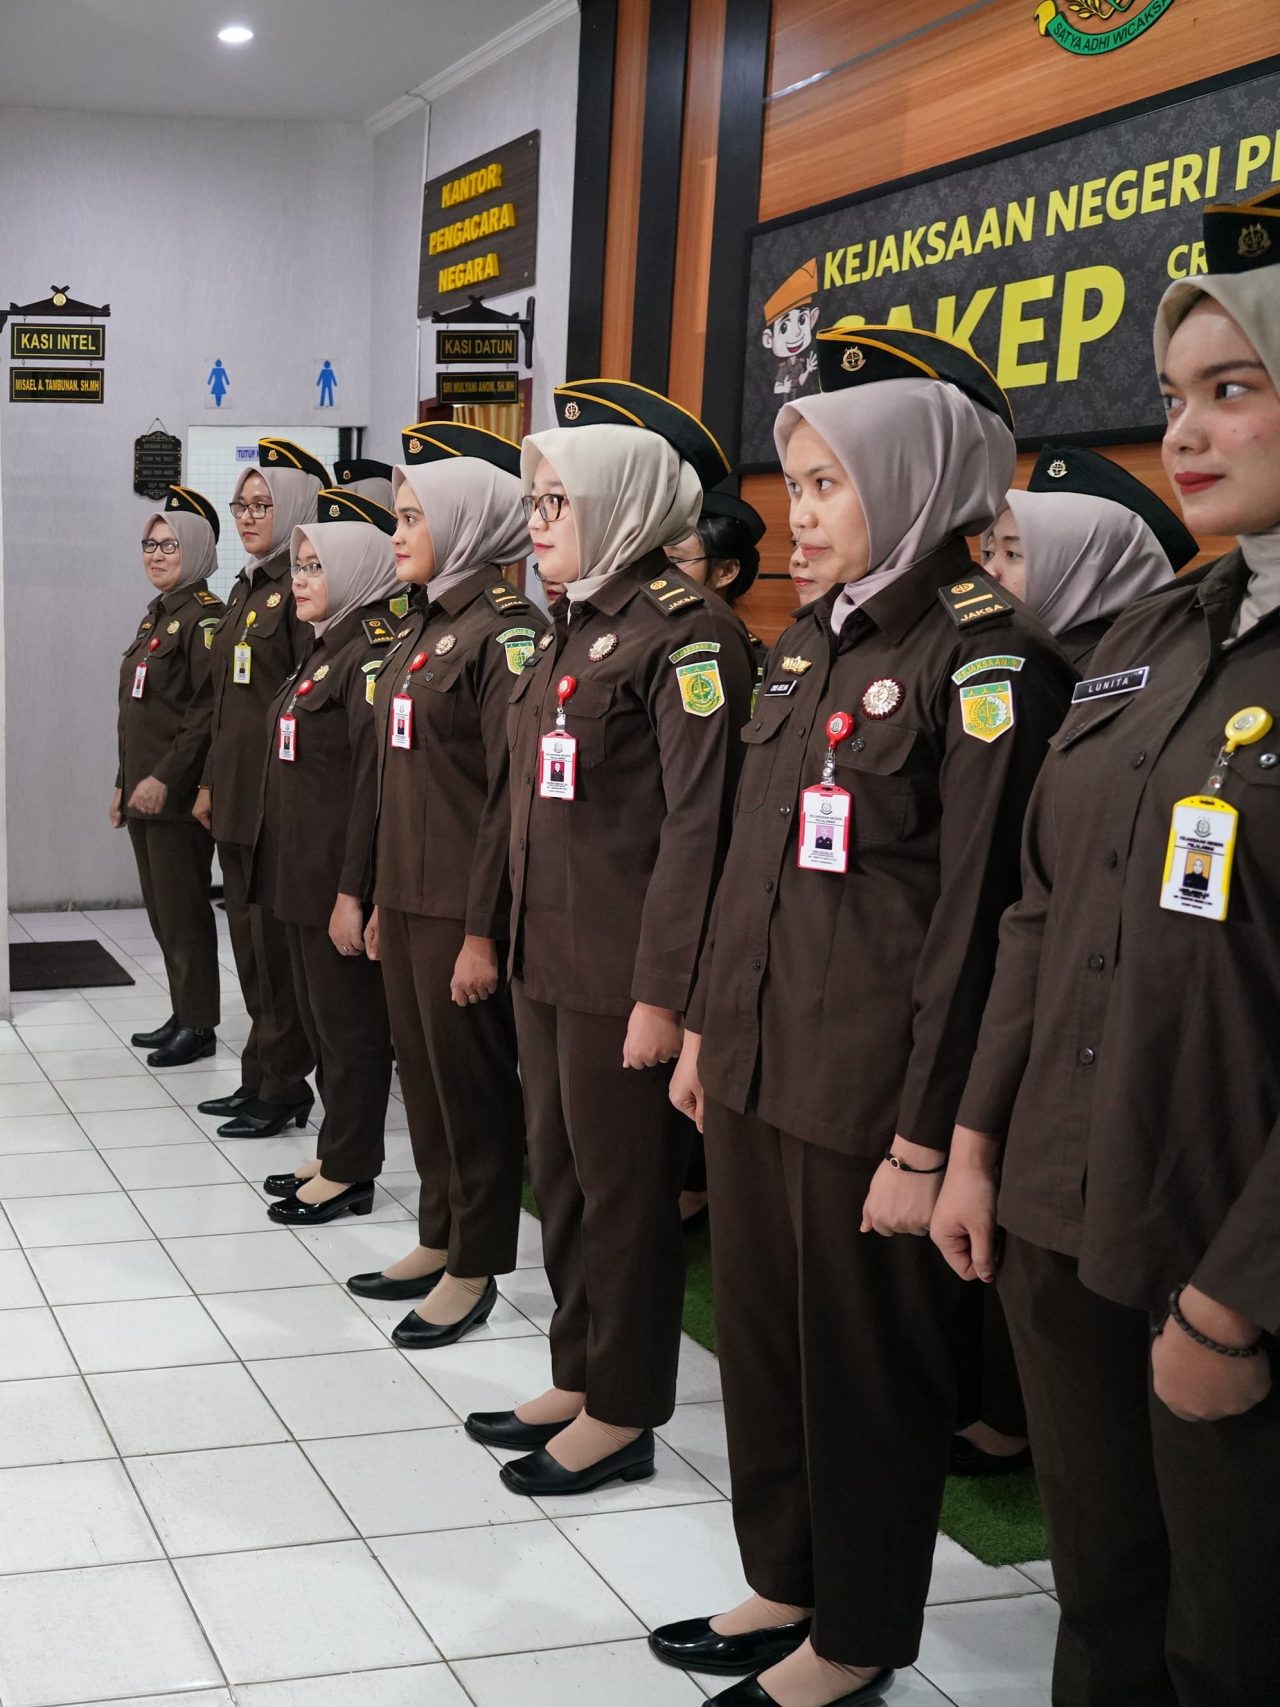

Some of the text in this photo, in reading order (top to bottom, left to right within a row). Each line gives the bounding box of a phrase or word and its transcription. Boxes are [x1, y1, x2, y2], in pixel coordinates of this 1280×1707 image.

[1053, 22, 1081, 50] SATYA
[1082, 36, 1110, 51] ADHI
[441, 163, 502, 209] KANTOR
[823, 196, 1036, 290] KEJAKSAAN
[1045, 146, 1221, 237] NEGERI
[428, 203, 515, 256] PENGACARA
[438, 253, 499, 293] NEGARA
[21, 333, 96, 350] KASI INTEL
[445, 339, 513, 354] KASI DATUN
[15, 379, 37, 391] MISAEL
[237, 449, 256, 458] TUTUP
[960, 603, 1004, 621] JAKSA
[1088, 677, 1128, 693] LUNITA
